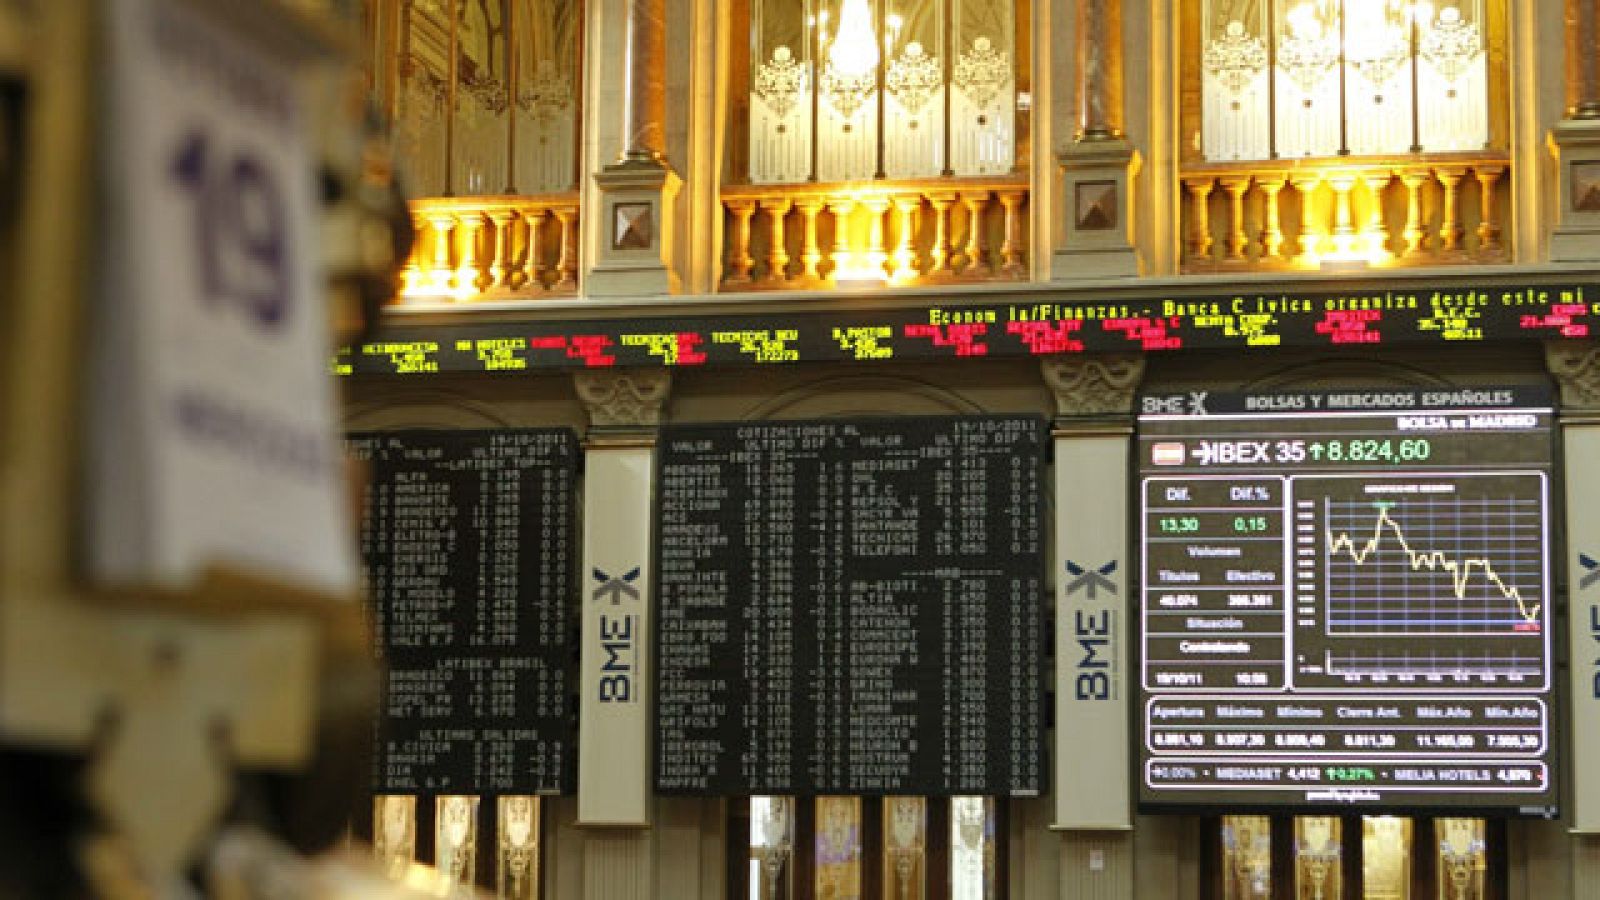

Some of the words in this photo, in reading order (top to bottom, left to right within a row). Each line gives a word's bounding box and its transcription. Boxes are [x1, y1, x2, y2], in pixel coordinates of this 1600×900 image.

[166, 120, 292, 345] 19
[1245, 394, 1306, 411] BOLSAS
[1310, 394, 1323, 409] Y
[1327, 391, 1416, 409] MERCADOS
[1421, 389, 1514, 407] ESPAÑOLES
[1274, 440, 1306, 462] 35
[599, 614, 630, 703] BME
[1076, 609, 1108, 701] BME
